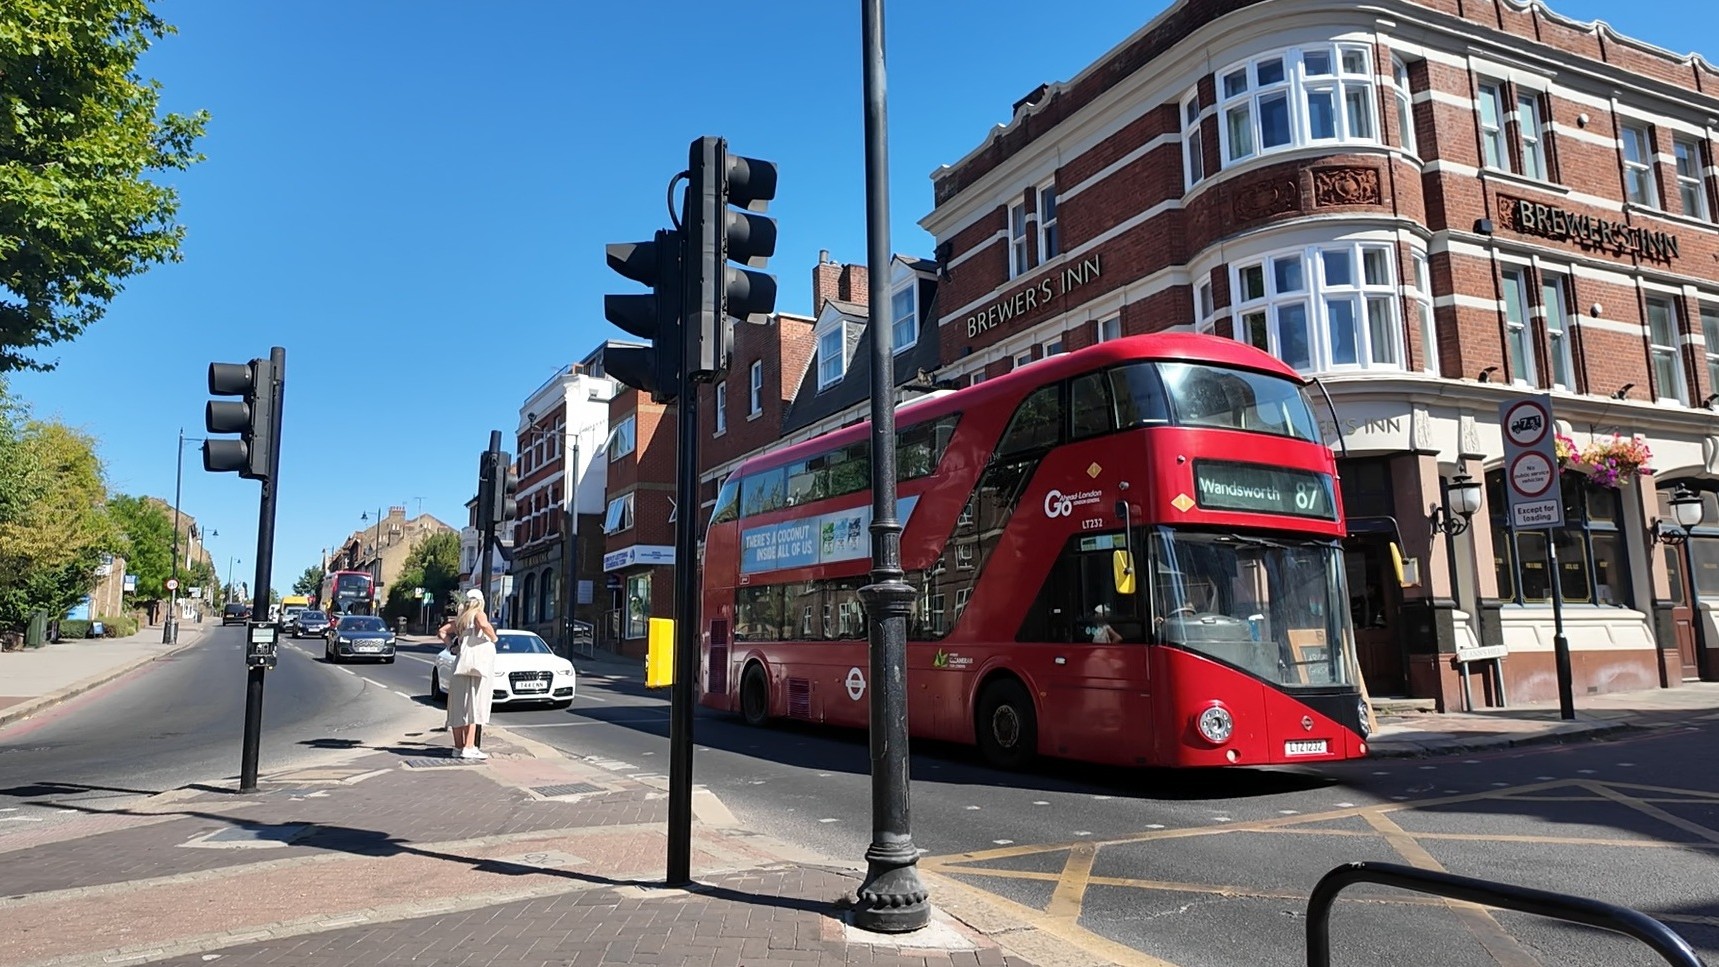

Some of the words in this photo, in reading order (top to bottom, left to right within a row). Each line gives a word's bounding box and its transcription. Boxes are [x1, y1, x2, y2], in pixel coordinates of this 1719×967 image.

[1519, 200, 1631, 246] BREWER'S
[1639, 229, 1679, 258] INN
[967, 278, 1052, 338] BREWER'S
[1061, 254, 1100, 294] INN
[1364, 418, 1401, 434] INN
[1044, 489, 1072, 518] Go
[1199, 476, 1280, 501] Wandsworth
[1296, 482, 1318, 509] 87
[1082, 518, 1103, 529] LT232
[1523, 514, 1551, 522] loading
[746, 532, 771, 548] THERE'S
[771, 532, 777, 545] A
[778, 525, 810, 541] COCONUT
[756, 546, 776, 561] INSIDE
[777, 545, 789, 558] ALL
[792, 543, 801, 556] OF
